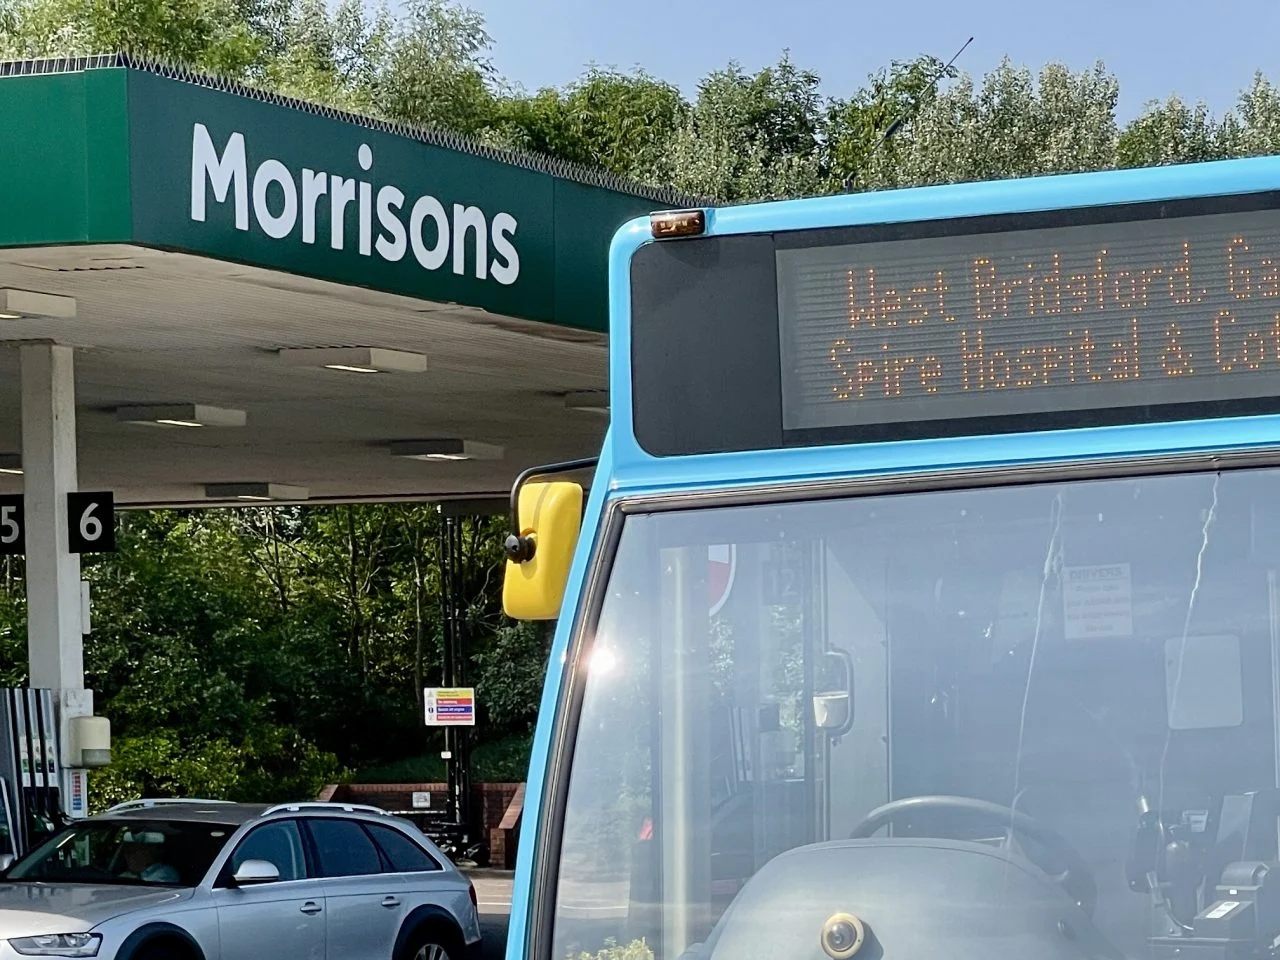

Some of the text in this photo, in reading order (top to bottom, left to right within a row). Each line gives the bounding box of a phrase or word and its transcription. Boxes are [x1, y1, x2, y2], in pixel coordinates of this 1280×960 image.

[191, 122, 520, 285] Morrisons
[848, 266, 954, 329] West
[829, 339, 943, 399] Spire
[960, 316, 1140, 391] Hospital
[1161, 322, 1194, 376] &
[1, 505, 20, 544] 5
[79, 502, 103, 541] 6
